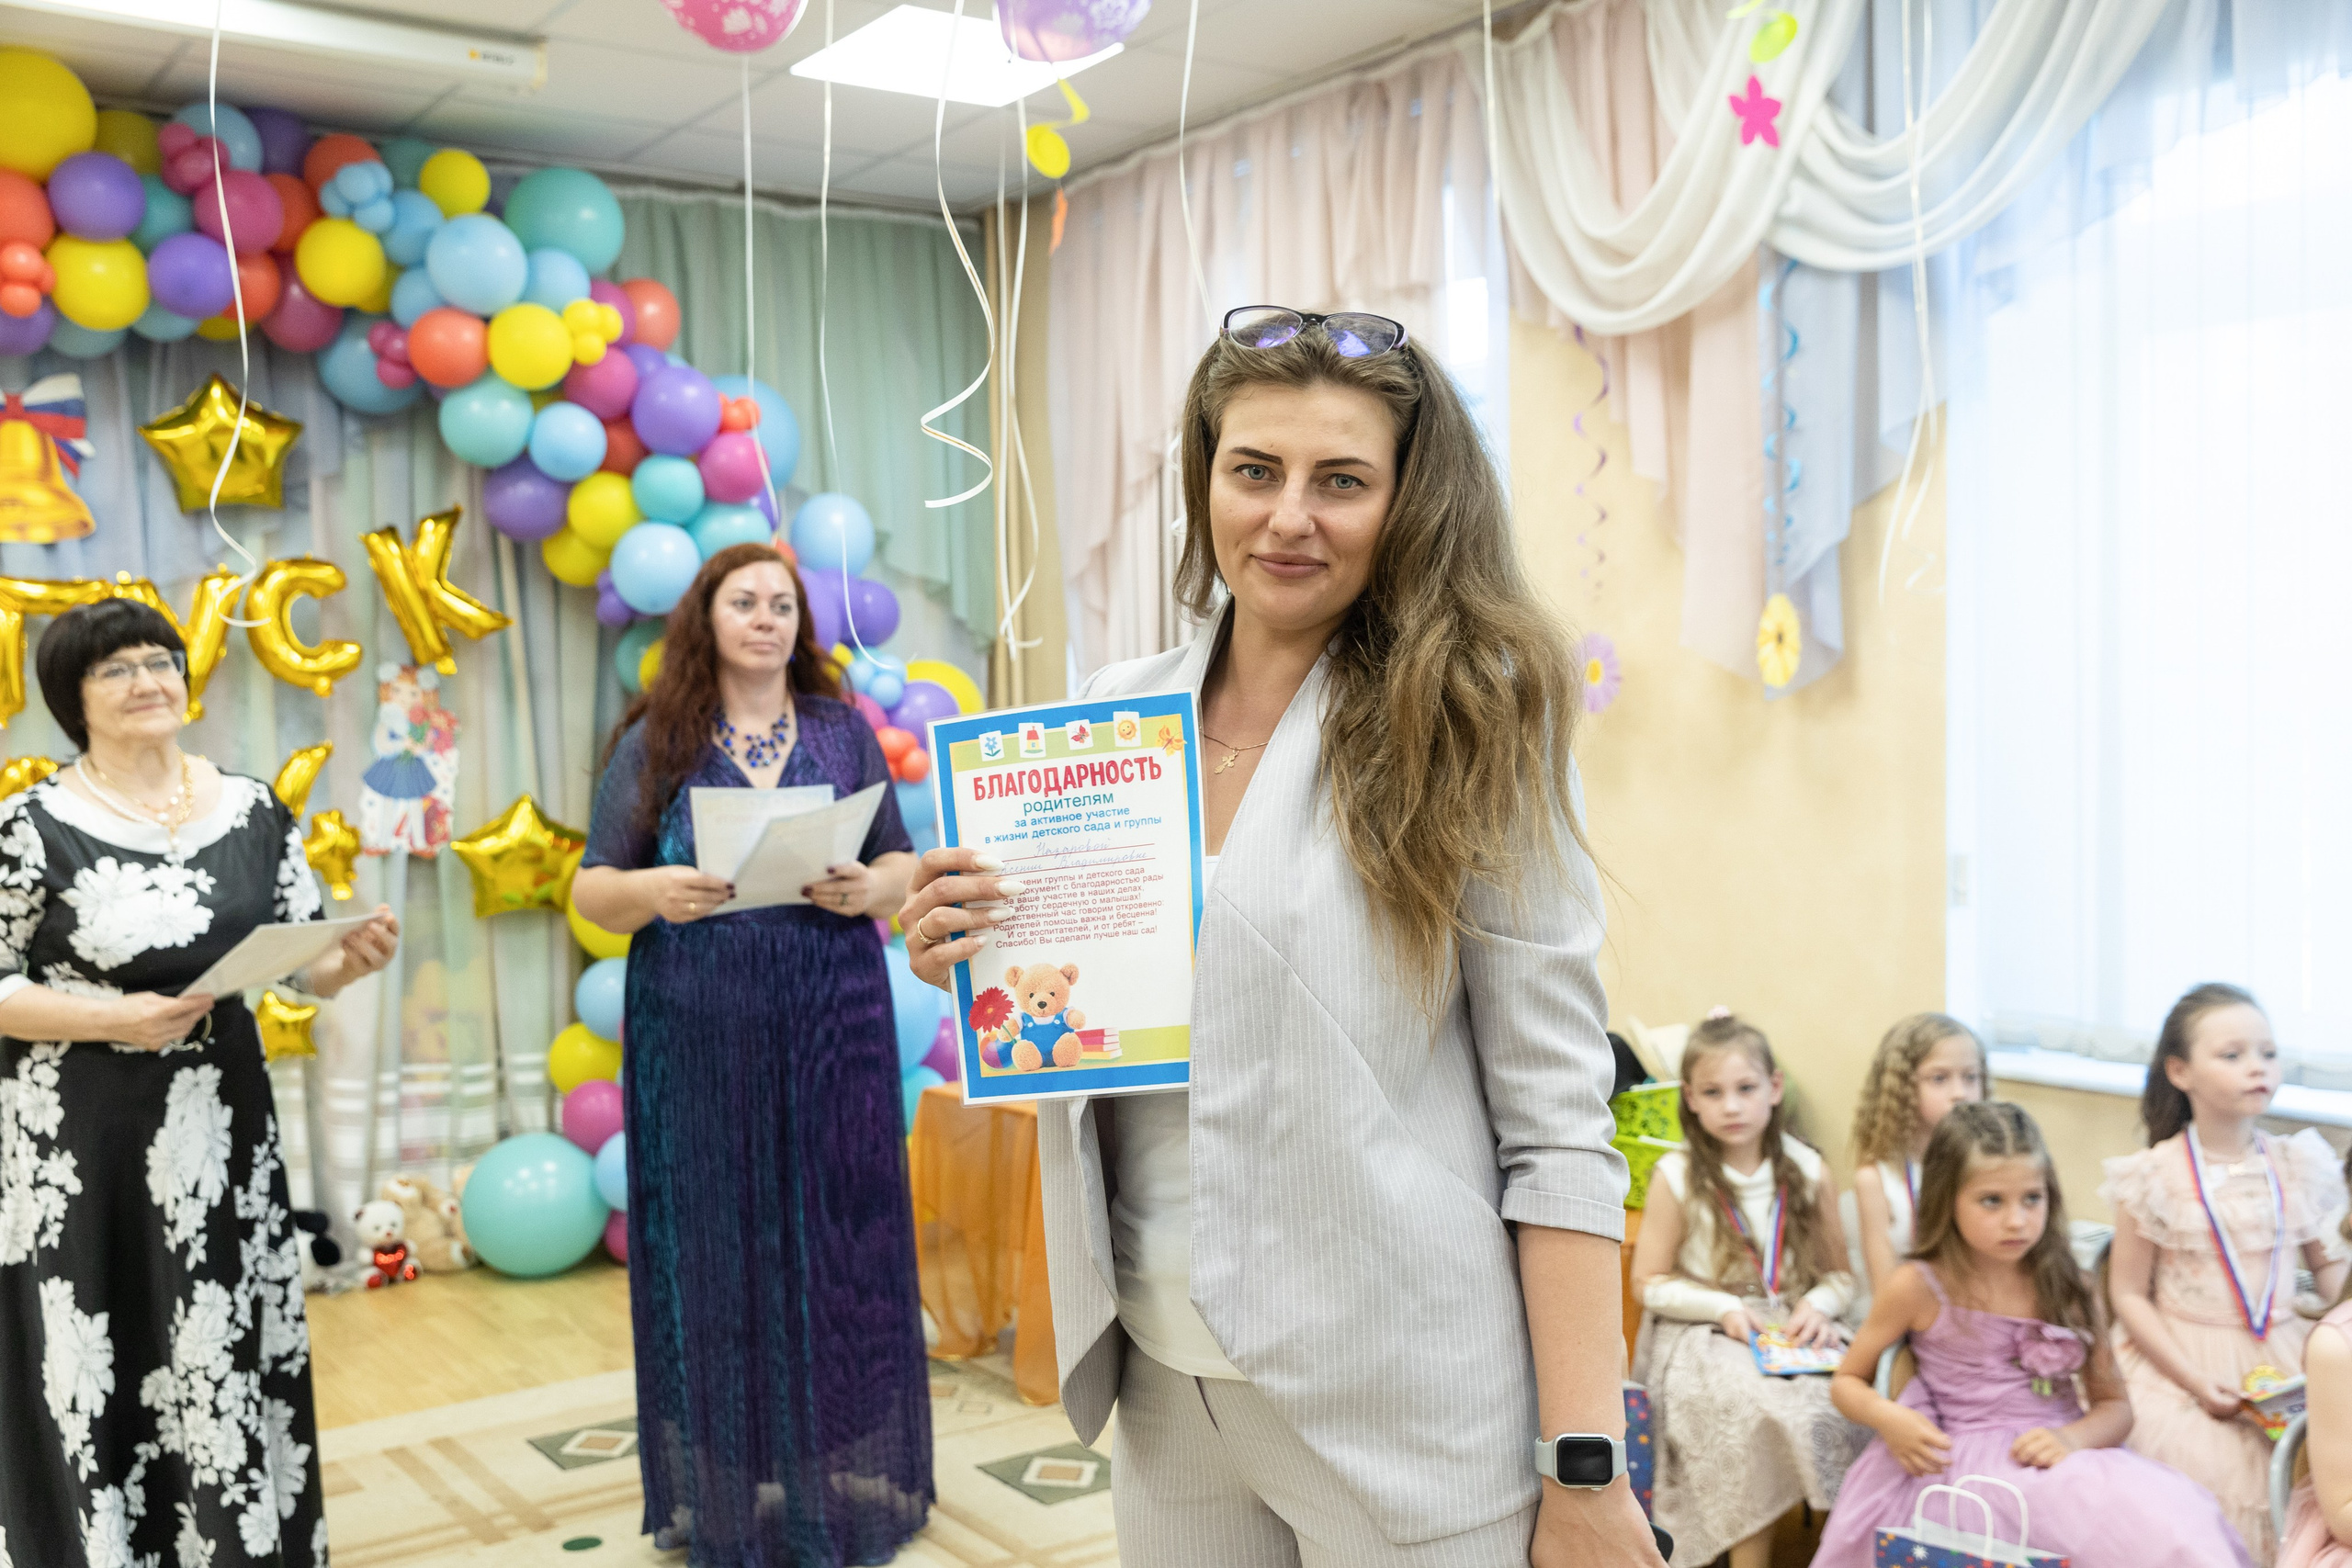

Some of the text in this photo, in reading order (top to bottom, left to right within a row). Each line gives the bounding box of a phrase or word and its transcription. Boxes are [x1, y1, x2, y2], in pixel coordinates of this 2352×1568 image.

[974, 756, 1161, 801] БЛАГОДАРНОСТЬ
[1023, 793, 1114, 816] родителям
[1014, 807, 1130, 828] за активное участие
[985, 816, 1162, 844] в жизни детского сада и группы
[1045, 874, 1076, 885] группы
[1085, 870, 1123, 880] детского
[1125, 867, 1145, 875] сада
[1071, 876, 1140, 889] благодарностью
[1142, 874, 1164, 884] рады
[1003, 897, 1014, 906] За
[1043, 891, 1078, 900] участие
[1088, 888, 1115, 897] наших
[1117, 885, 1144, 895] делах,
[1042, 898, 1090, 910] сердечную
[1100, 892, 1141, 903] малышах!
[993, 920, 1041, 932] Родителей
[1044, 918, 1079, 927] помощь
[1080, 915, 1106, 923] важна
[1116, 908, 1158, 919] бесценна!
[1079, 906, 1114, 915] говорим
[995, 937, 1036, 948] Спасибо!
[1039, 936, 1052, 944] Вы
[1055, 933, 1091, 943] сделали
[1093, 931, 1120, 941] лучше
[1140, 925, 1158, 934] сад!
[1007, 931, 1014, 939] И
[1029, 924, 1091, 936] воспитателей,
[1113, 919, 1136, 930] ребят
